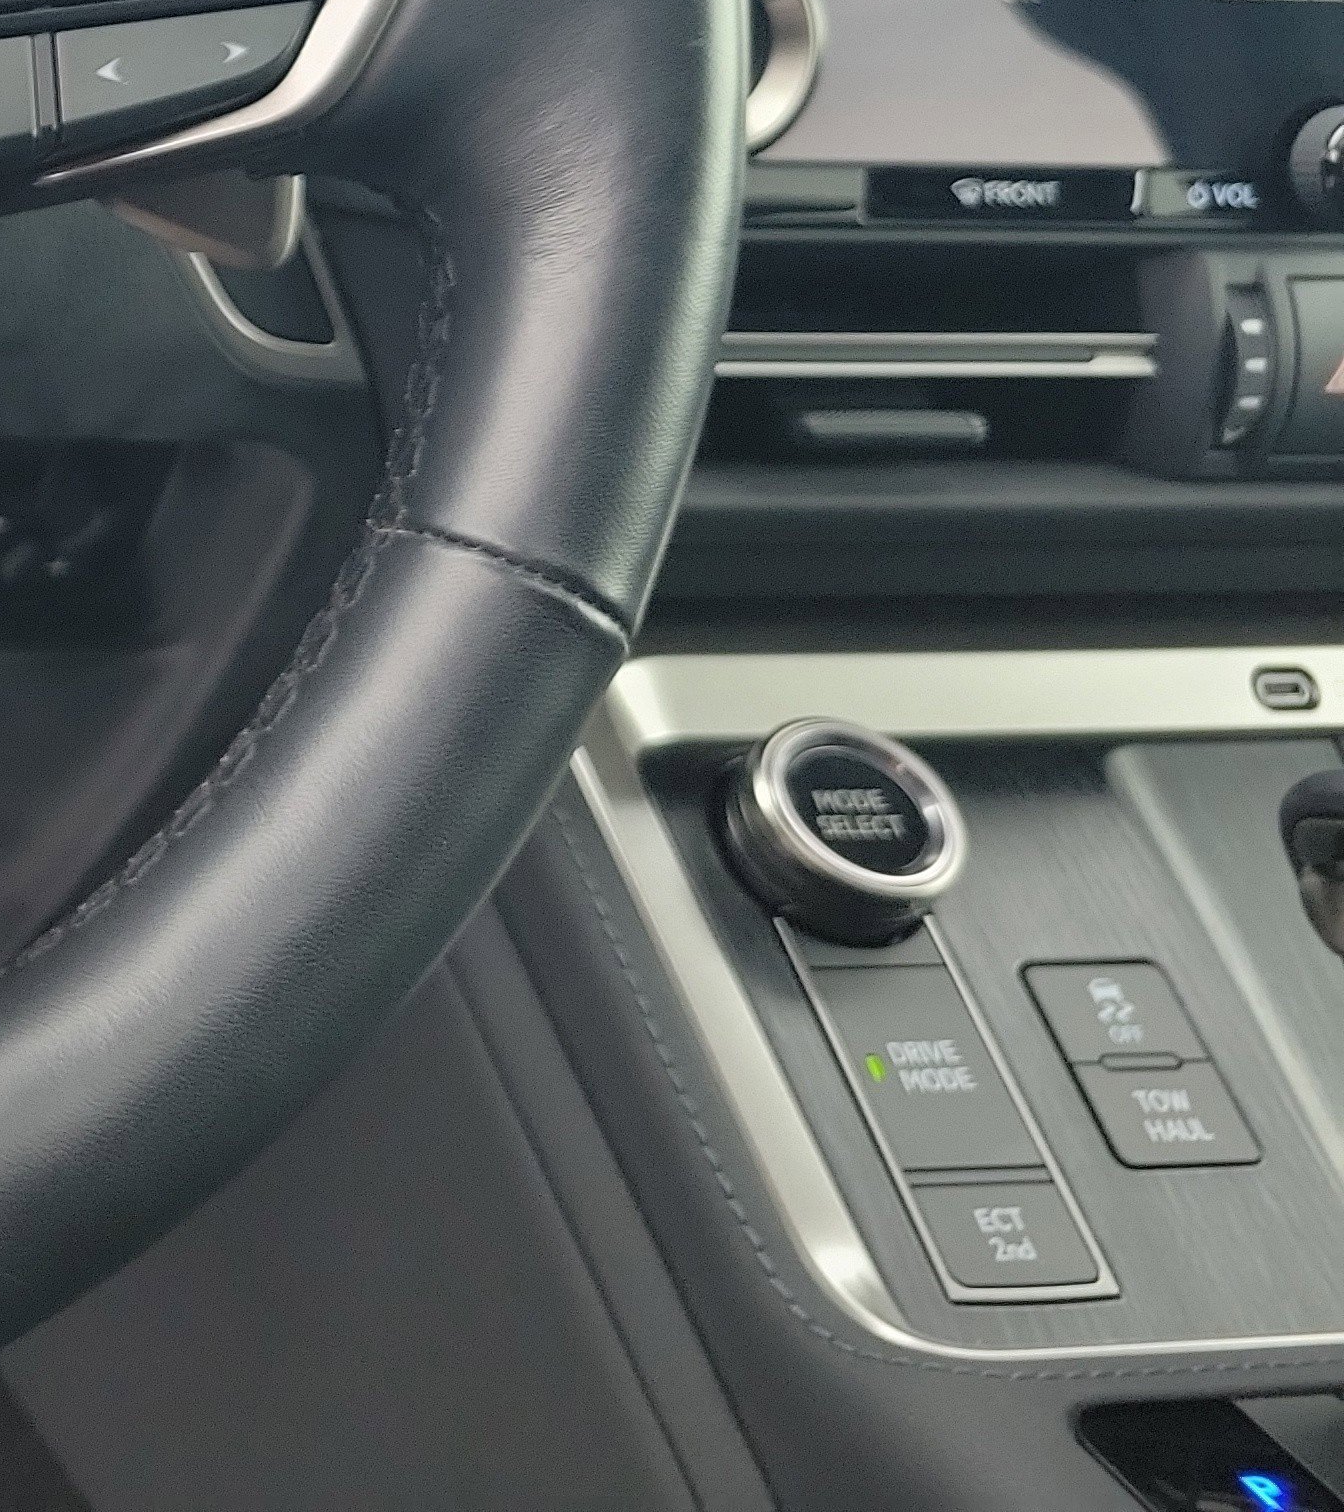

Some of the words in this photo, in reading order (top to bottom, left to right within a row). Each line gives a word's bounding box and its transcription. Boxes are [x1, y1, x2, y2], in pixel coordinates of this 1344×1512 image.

[983, 180, 1060, 209] FRONT
[1212, 182, 1260, 209] VOL
[812, 788, 892, 815] MODE
[816, 814, 907, 841] SELECT
[886, 1039, 962, 1065] DRIVE
[898, 1066, 978, 1092] MODE
[1132, 1089, 1191, 1113] TOW
[1143, 1118, 1216, 1142] HAUL
[973, 1207, 1025, 1232] ECT
[989, 1235, 1038, 1262] 2nd
[1238, 1475, 1286, 1512] P
